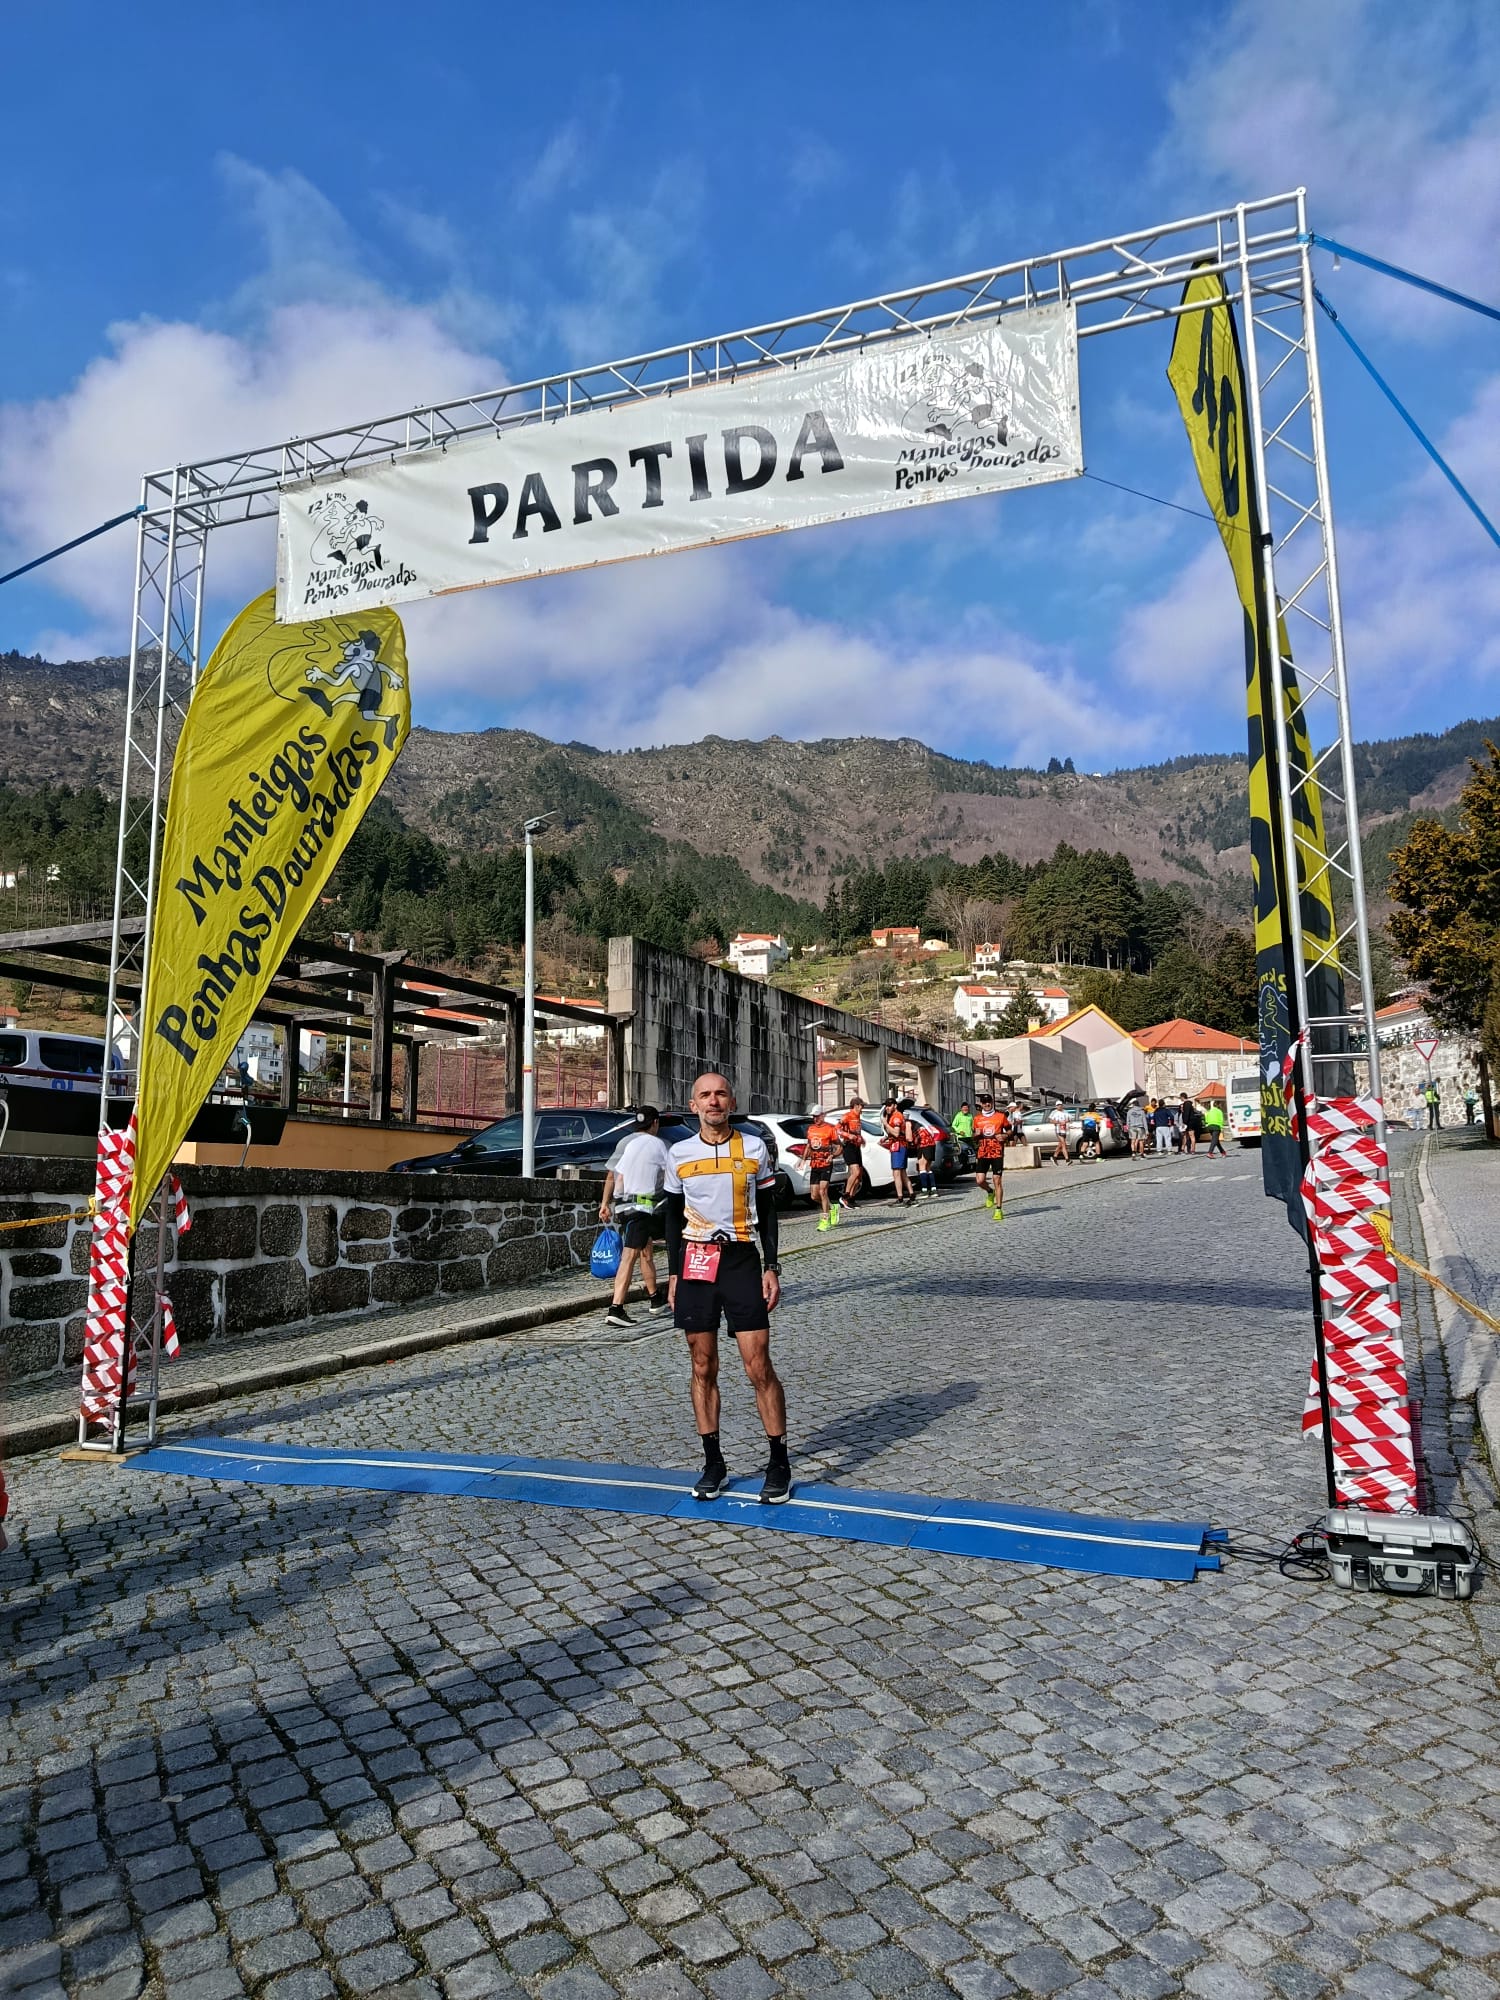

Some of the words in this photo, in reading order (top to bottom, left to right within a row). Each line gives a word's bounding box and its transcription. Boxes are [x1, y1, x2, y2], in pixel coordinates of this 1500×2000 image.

[895, 434, 996, 466] Manteigas
[895, 461, 959, 490] Penhas
[967, 437, 1061, 472] Douradas
[466, 409, 845, 545] PARTIDA
[307, 500, 323, 515] 12
[325, 492, 348, 506] kms
[303, 582, 349, 605] Penhas
[354, 562, 418, 592] Douradas
[305, 561, 377, 586] Manteigas
[175, 725, 328, 928] Manteigas
[155, 905, 273, 1067] Penhas
[251, 730, 379, 924] Douradas
[591, 1249, 613, 1259] DELL
[690, 1253, 711, 1266] 127
